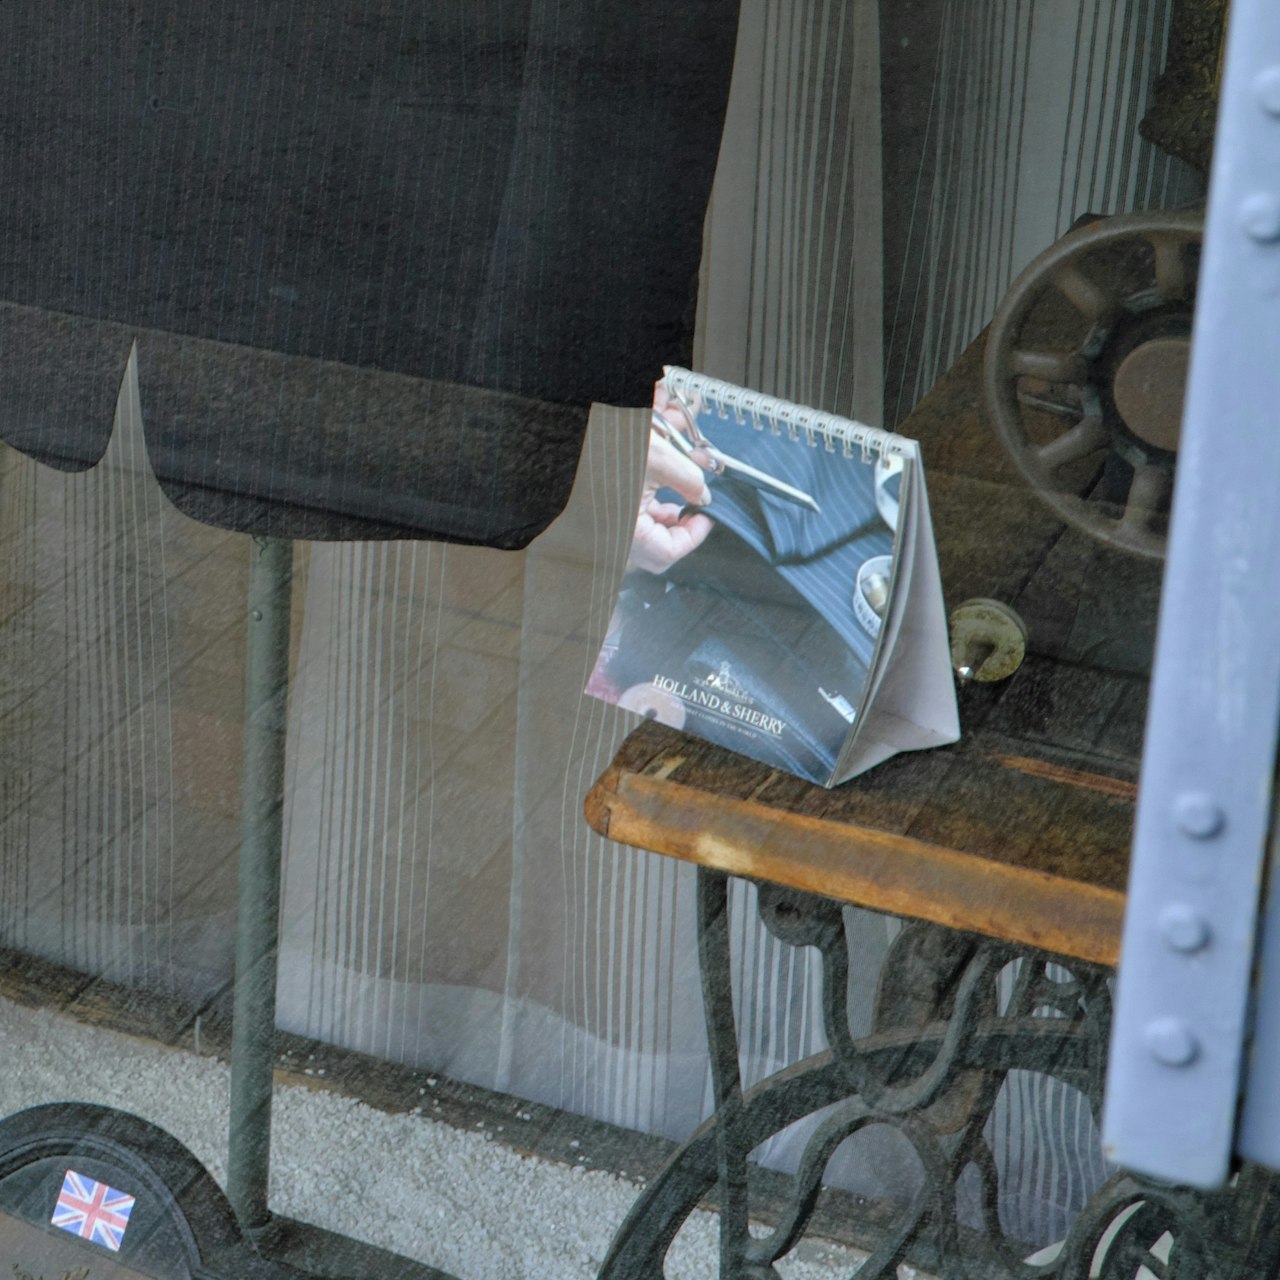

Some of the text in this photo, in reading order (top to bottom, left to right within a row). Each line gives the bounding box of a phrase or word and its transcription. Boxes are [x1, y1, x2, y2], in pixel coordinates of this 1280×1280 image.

[652, 674, 721, 709] HOLLAND
[720, 701, 731, 715] &
[731, 704, 786, 734] SHERRY
